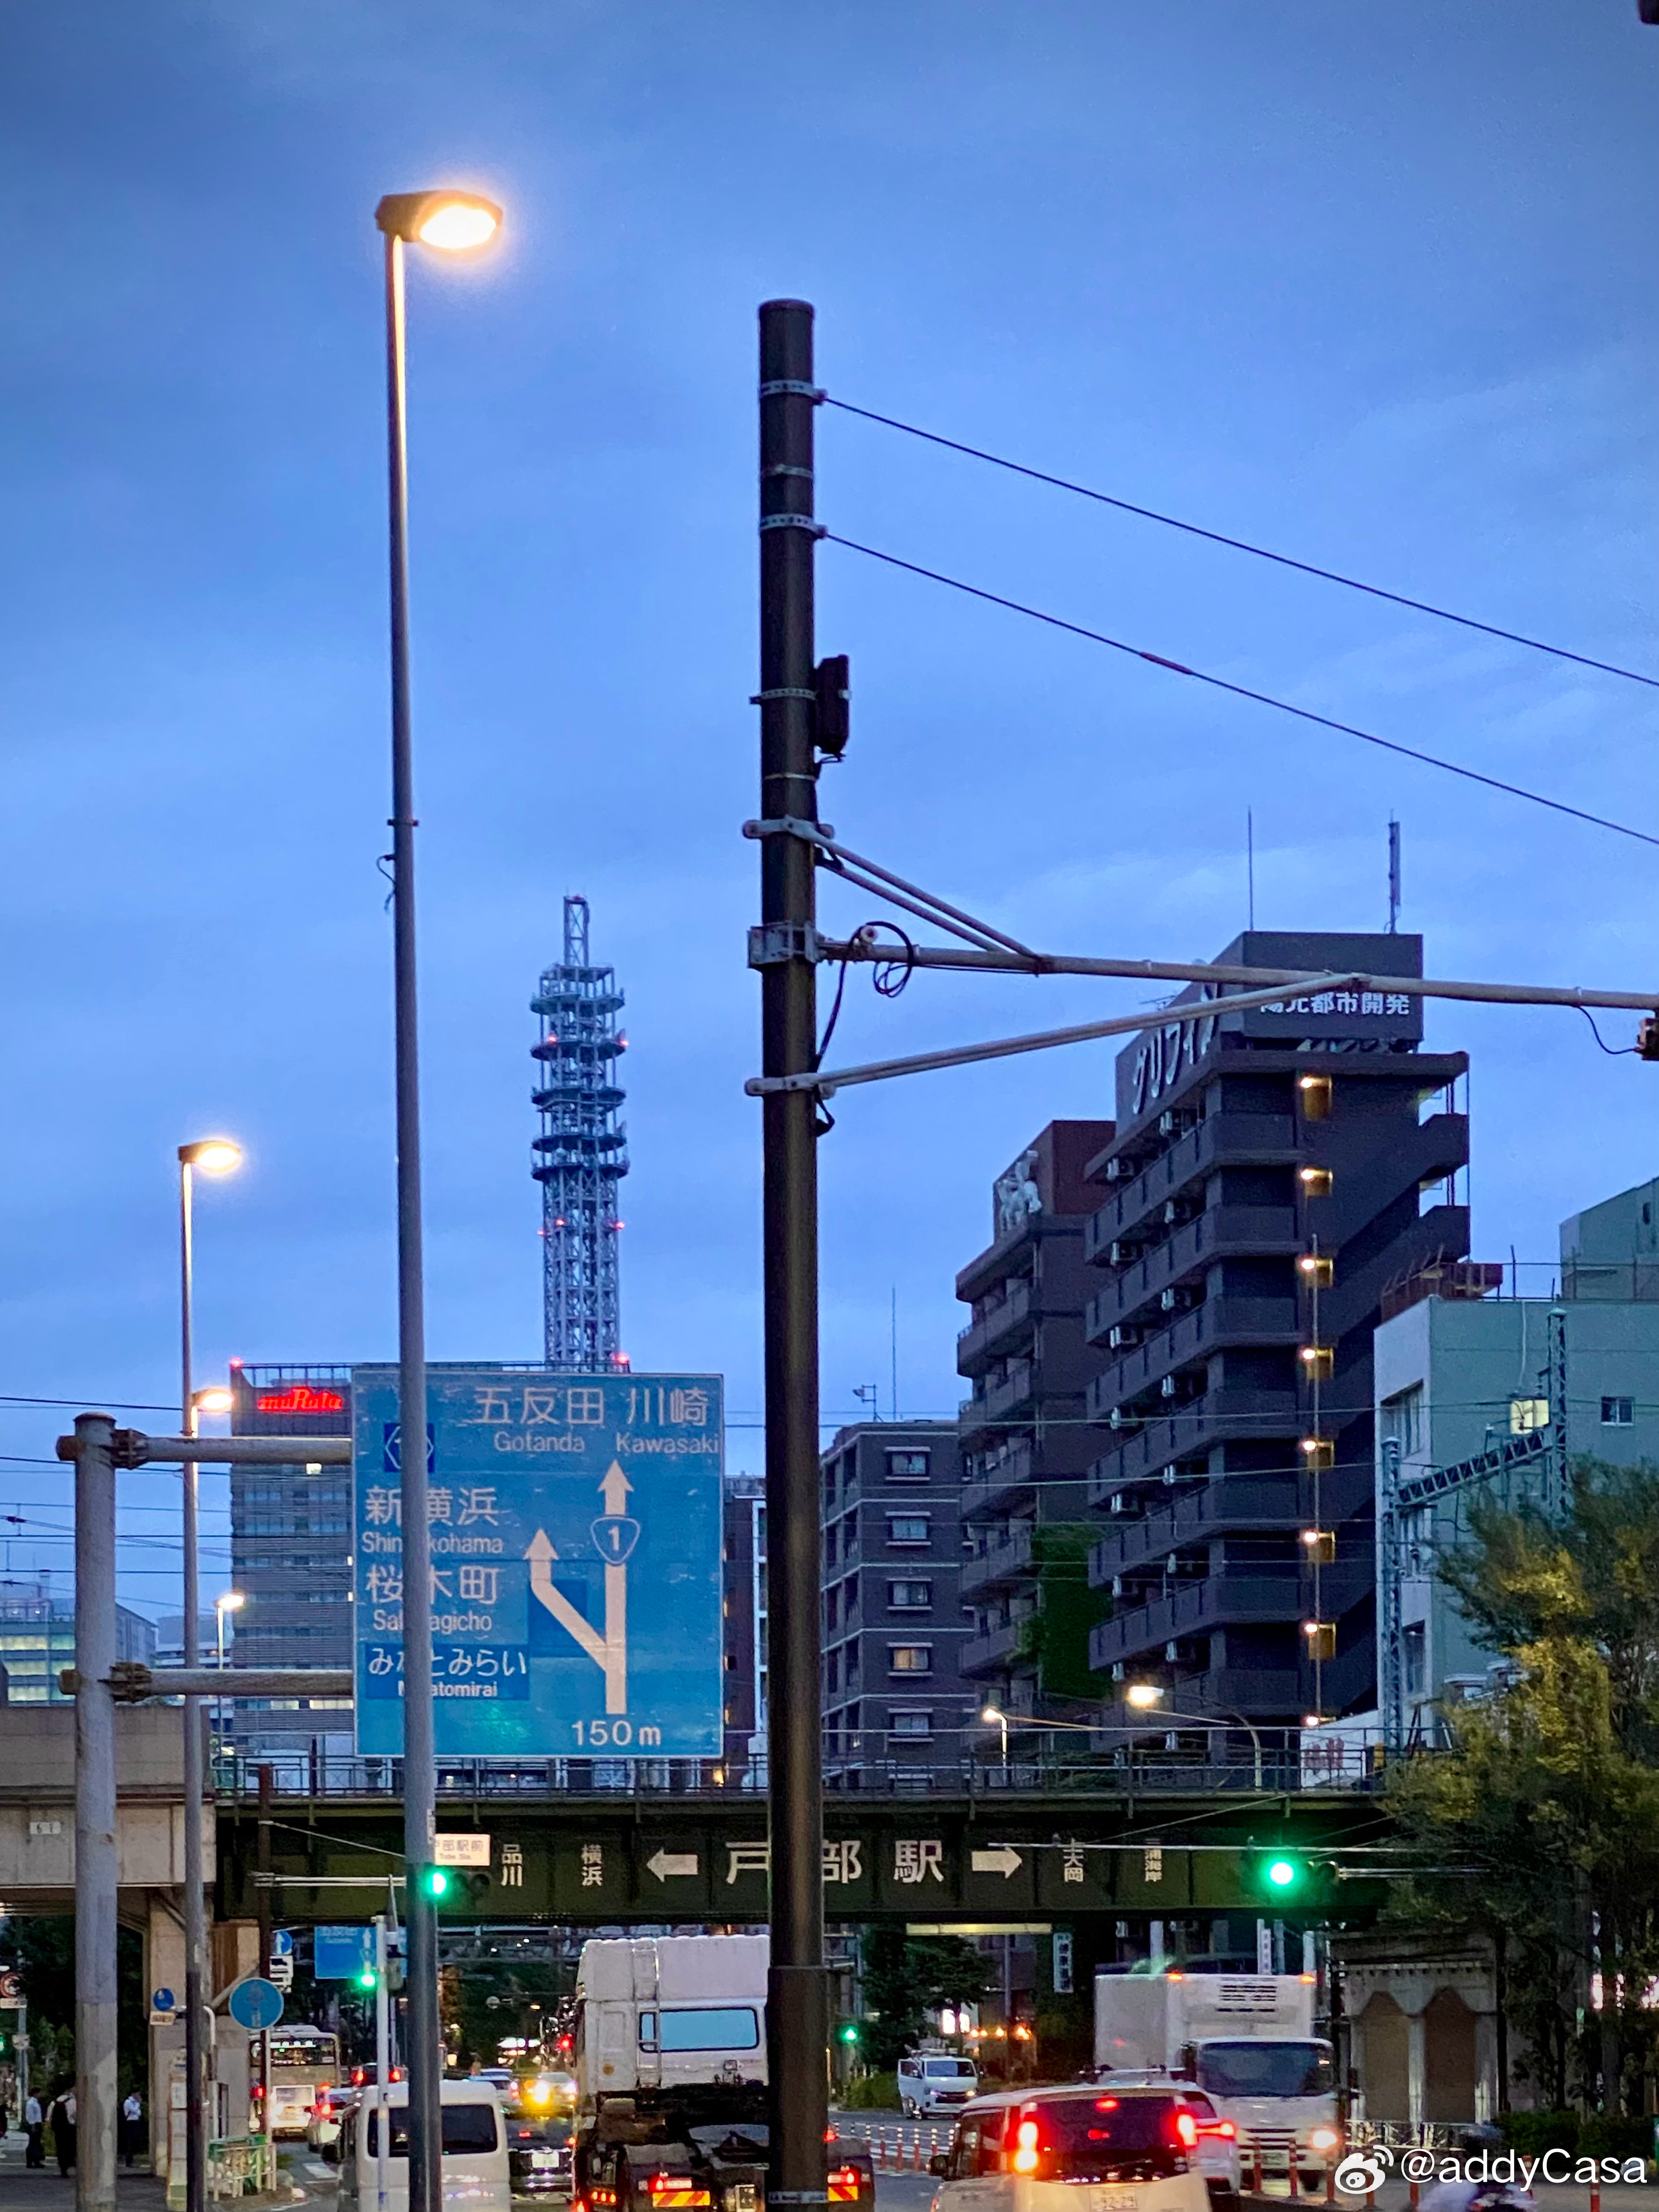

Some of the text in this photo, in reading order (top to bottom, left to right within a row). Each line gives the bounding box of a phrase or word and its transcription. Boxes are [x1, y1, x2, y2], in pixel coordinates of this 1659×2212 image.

[475, 1387, 708, 1426] 五反田 川崎
[494, 1431, 718, 1454] Gotanda Kawasaki
[607, 1525, 620, 1552] 1
[571, 1720, 661, 1746] 150 m
[500, 1843, 523, 1886] 品川
[581, 1843, 603, 1886] 横浜
